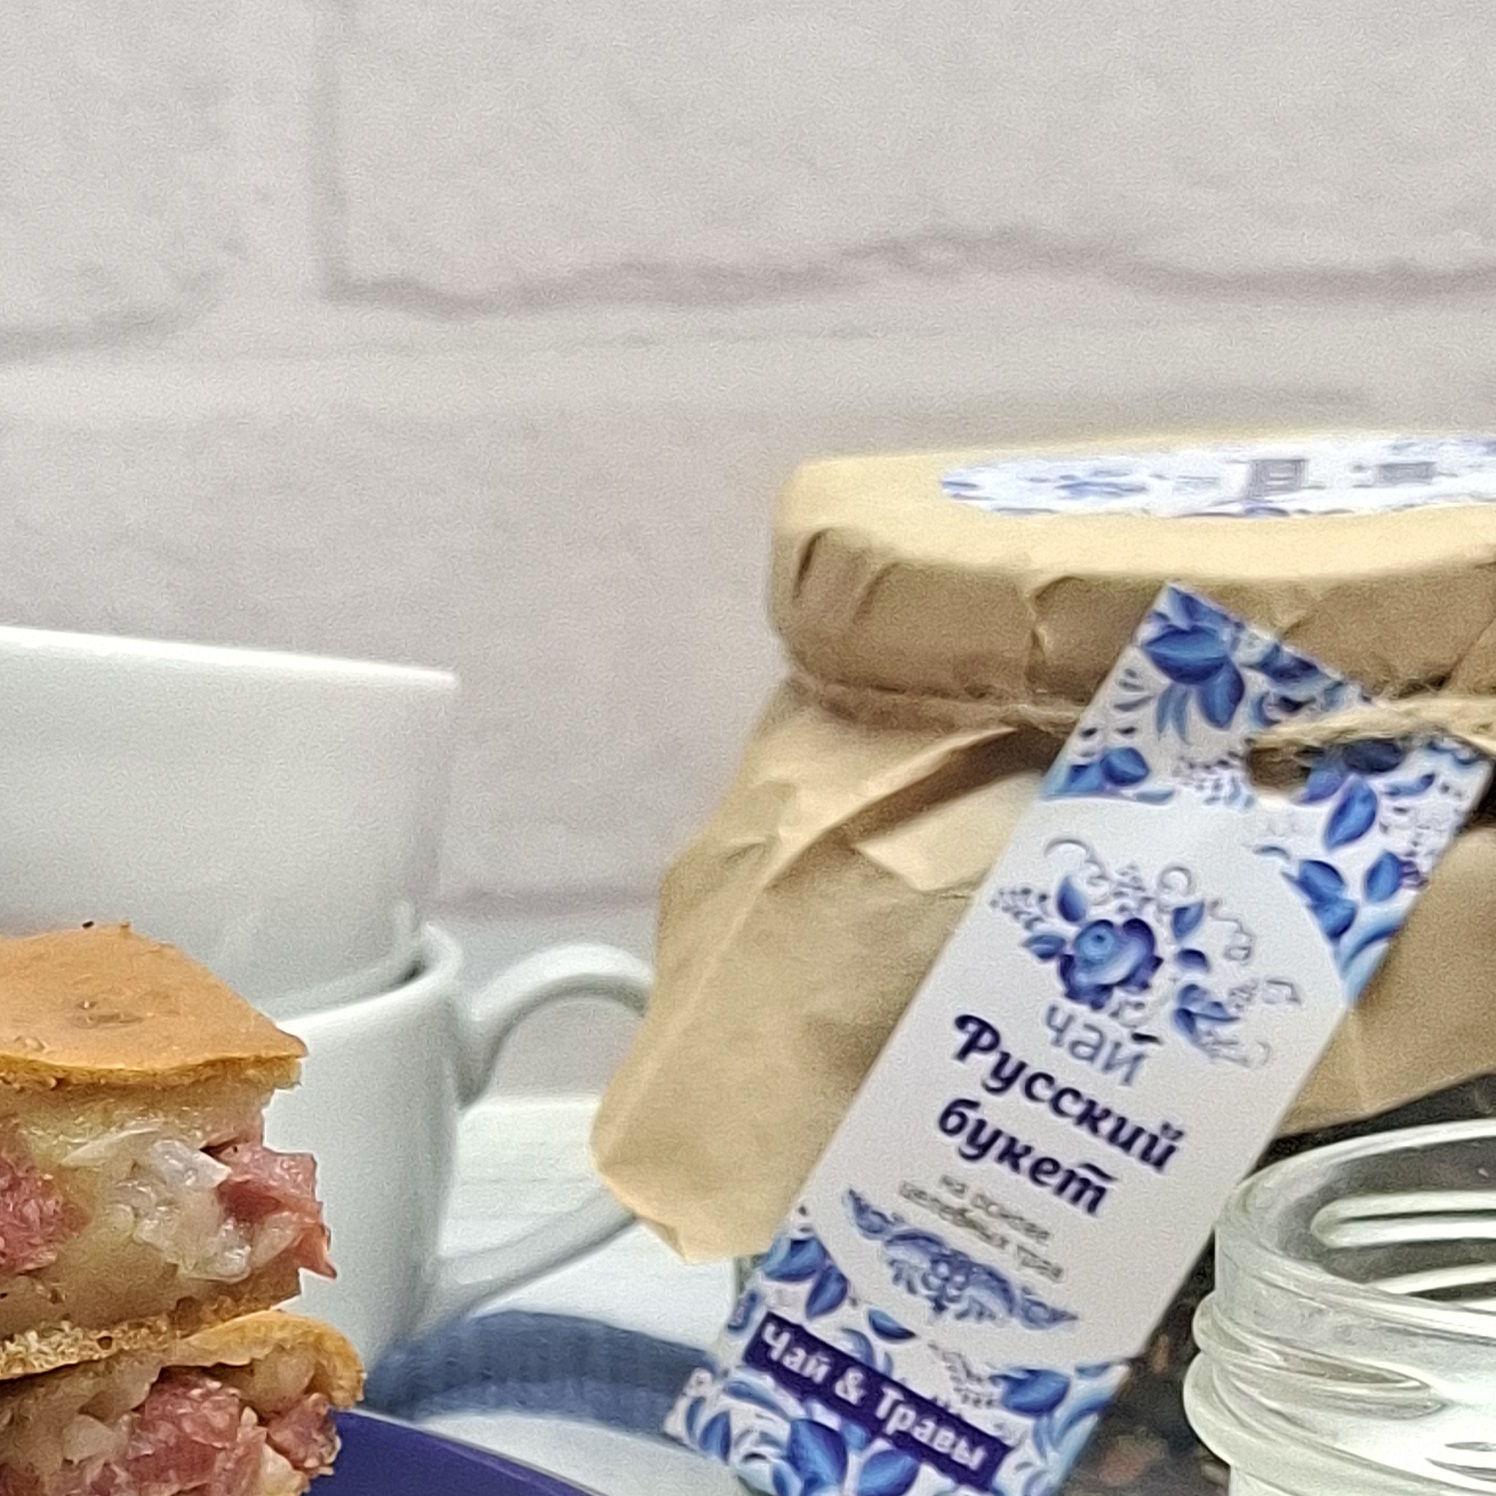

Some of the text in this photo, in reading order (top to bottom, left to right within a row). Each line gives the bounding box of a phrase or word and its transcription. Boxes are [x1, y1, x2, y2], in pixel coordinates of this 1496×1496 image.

[938, 1098, 1118, 1216] букет
[954, 1014, 1184, 1174] Русский
[761, 1322, 987, 1470] Чай & Травы
